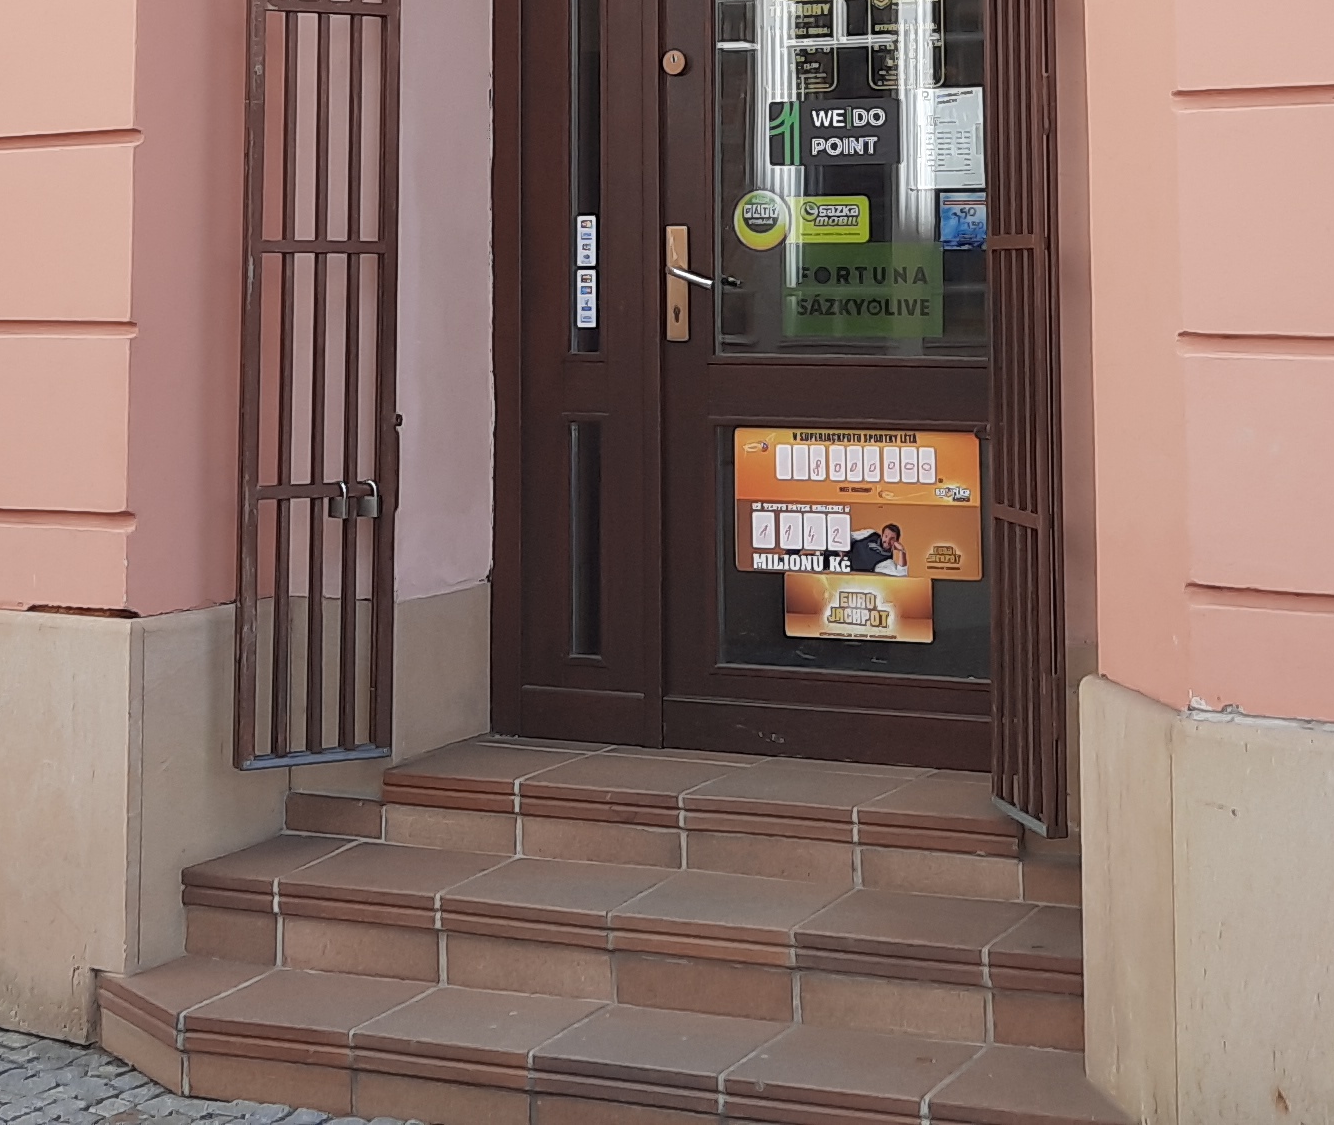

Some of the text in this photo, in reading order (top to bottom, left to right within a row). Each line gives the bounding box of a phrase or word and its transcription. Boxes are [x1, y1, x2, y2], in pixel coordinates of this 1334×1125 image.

[811, 136, 879, 157] POINT
[798, 266, 929, 285] FORTUNA
[829, 556, 851, 573] Kč
[839, 592, 877, 609] EURO
